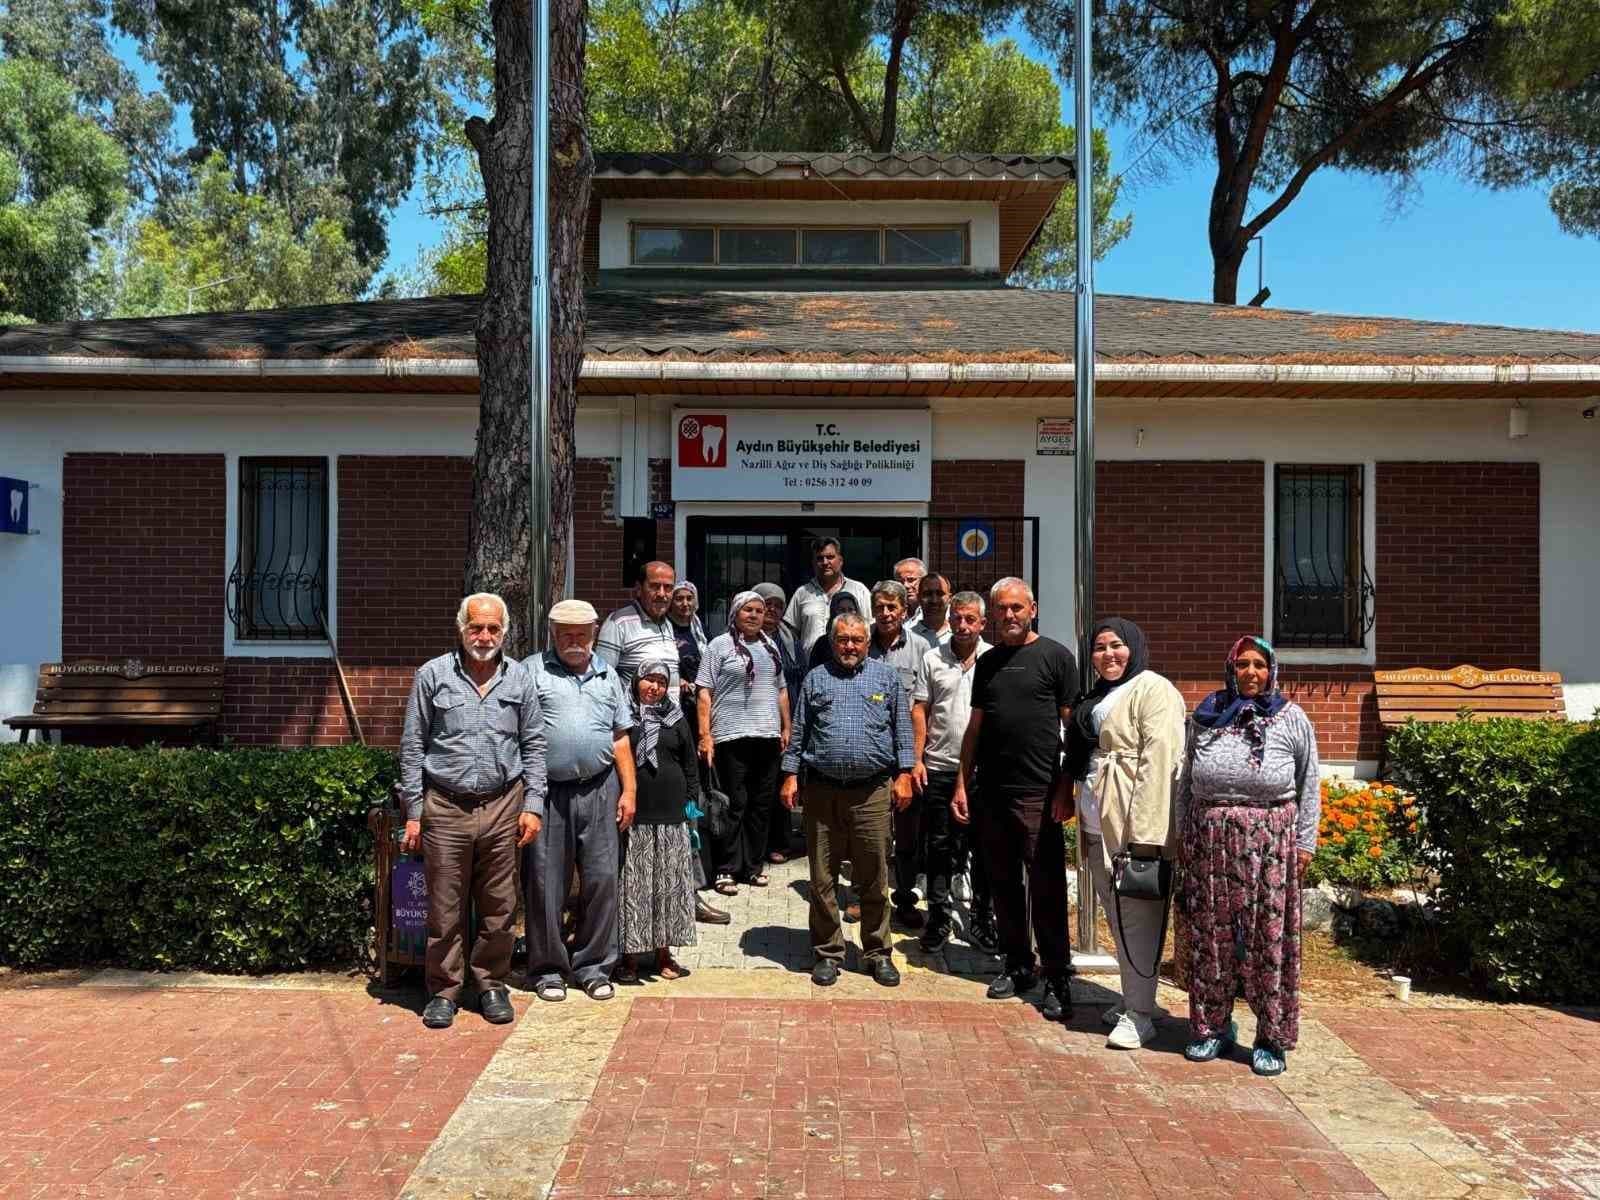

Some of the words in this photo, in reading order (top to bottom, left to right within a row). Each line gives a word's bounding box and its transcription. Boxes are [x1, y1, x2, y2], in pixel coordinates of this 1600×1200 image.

[815, 423, 840, 436] T.C.
[736, 440, 774, 455] Aydın
[777, 439, 850, 455] Büyükşehir
[853, 439, 921, 455] Belediyesi
[741, 459, 772, 470] Nazilli
[774, 459, 796, 471] Ağız
[799, 461, 810, 470] ve
[811, 459, 828, 471] Diş
[829, 459, 862, 471] Sağlığı
[865, 459, 915, 472] Polikliniği
[784, 477, 797, 487] Tel
[804, 478, 827, 487] 0256
[829, 478, 846, 487] 312
[847, 478, 859, 487] 40
[861, 478, 872, 487] 09
